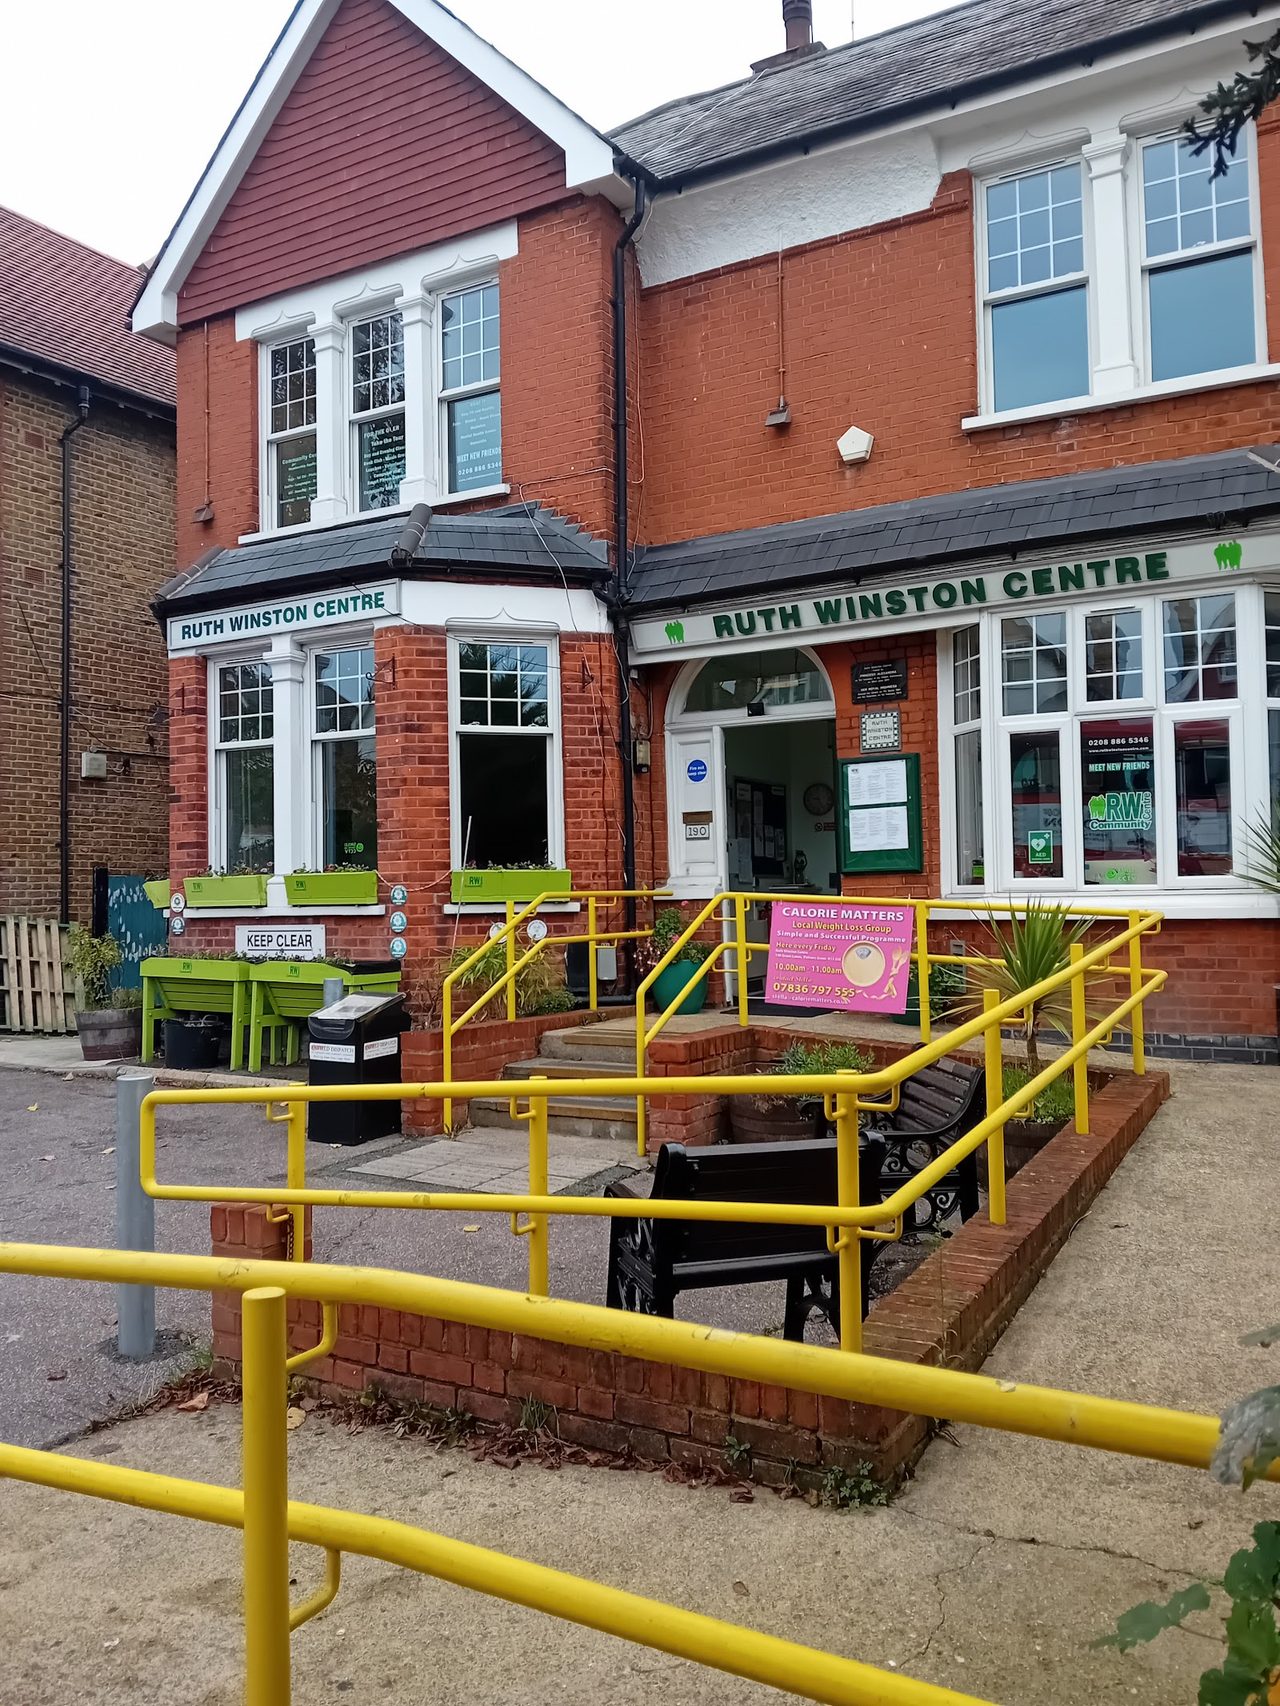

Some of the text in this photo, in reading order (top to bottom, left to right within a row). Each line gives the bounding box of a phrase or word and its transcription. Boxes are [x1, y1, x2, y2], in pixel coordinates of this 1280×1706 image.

[713, 552, 1170, 638] RUTH WINSTON CENTRE
[181, 591, 385, 640] RUTH WINSTON CENTRE
[1088, 736, 1149, 746] 0208 886 5346
[1088, 761, 1150, 772] MEET NEW FRIENDS
[1106, 792, 1142, 821] RW
[1142, 791, 1151, 821] Centre
[688, 827, 707, 836] 190
[1090, 820, 1151, 831] Community
[469, 876, 480, 885] RW
[782, 907, 904, 921] CALORIE MATTERS
[792, 921, 892, 934] Local Weight Loss Group
[247, 934, 312, 947] KEEP CLEAR
[777, 930, 803, 939] Simple
[820, 933, 860, 941] Successful
[861, 934, 906, 943] Programme
[776, 941, 836, 952] Here every Friday
[775, 963, 806, 971] 10.00am
[811, 965, 842, 974] 11.00am
[773, 982, 856, 997] 07836 797 555
